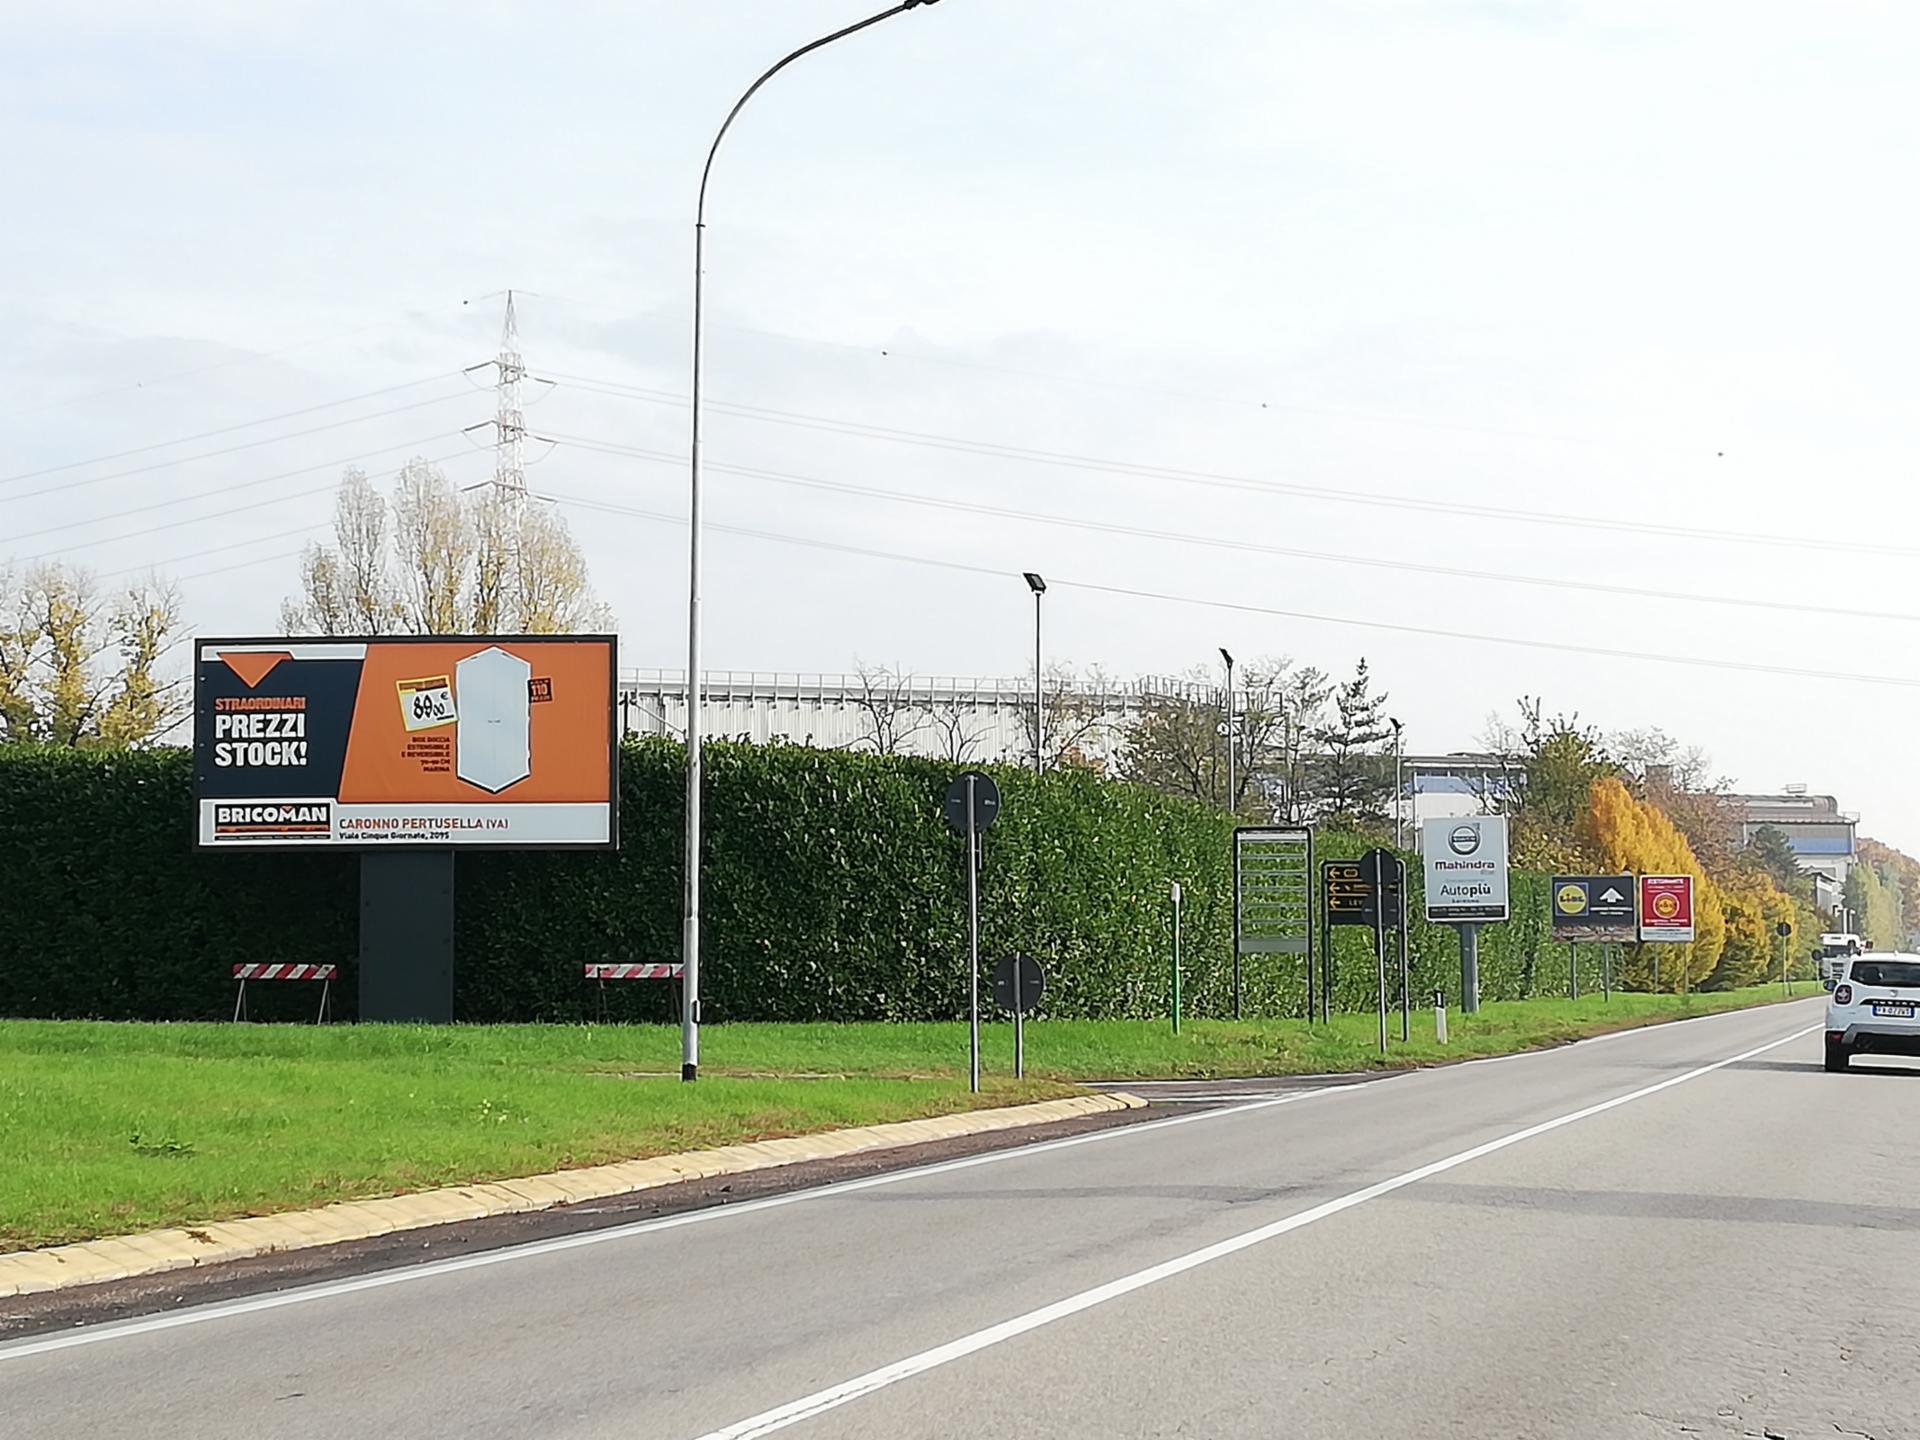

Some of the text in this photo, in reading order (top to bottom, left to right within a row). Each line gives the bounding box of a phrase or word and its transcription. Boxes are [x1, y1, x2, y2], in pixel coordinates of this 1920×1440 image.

[531, 683, 548, 696] 110
[215, 697, 306, 711] STRAORDINARI
[215, 713, 305, 739] PREZZI
[214, 741, 307, 767] STOCK!
[218, 807, 328, 823] BRICOMAN
[339, 818, 399, 829] CARONNO
[402, 818, 483, 829] PERTUSELLA
[486, 818, 509, 829] (VA)
[361, 832, 389, 840] Cinque
[1435, 861, 1495, 870] Mahindra
